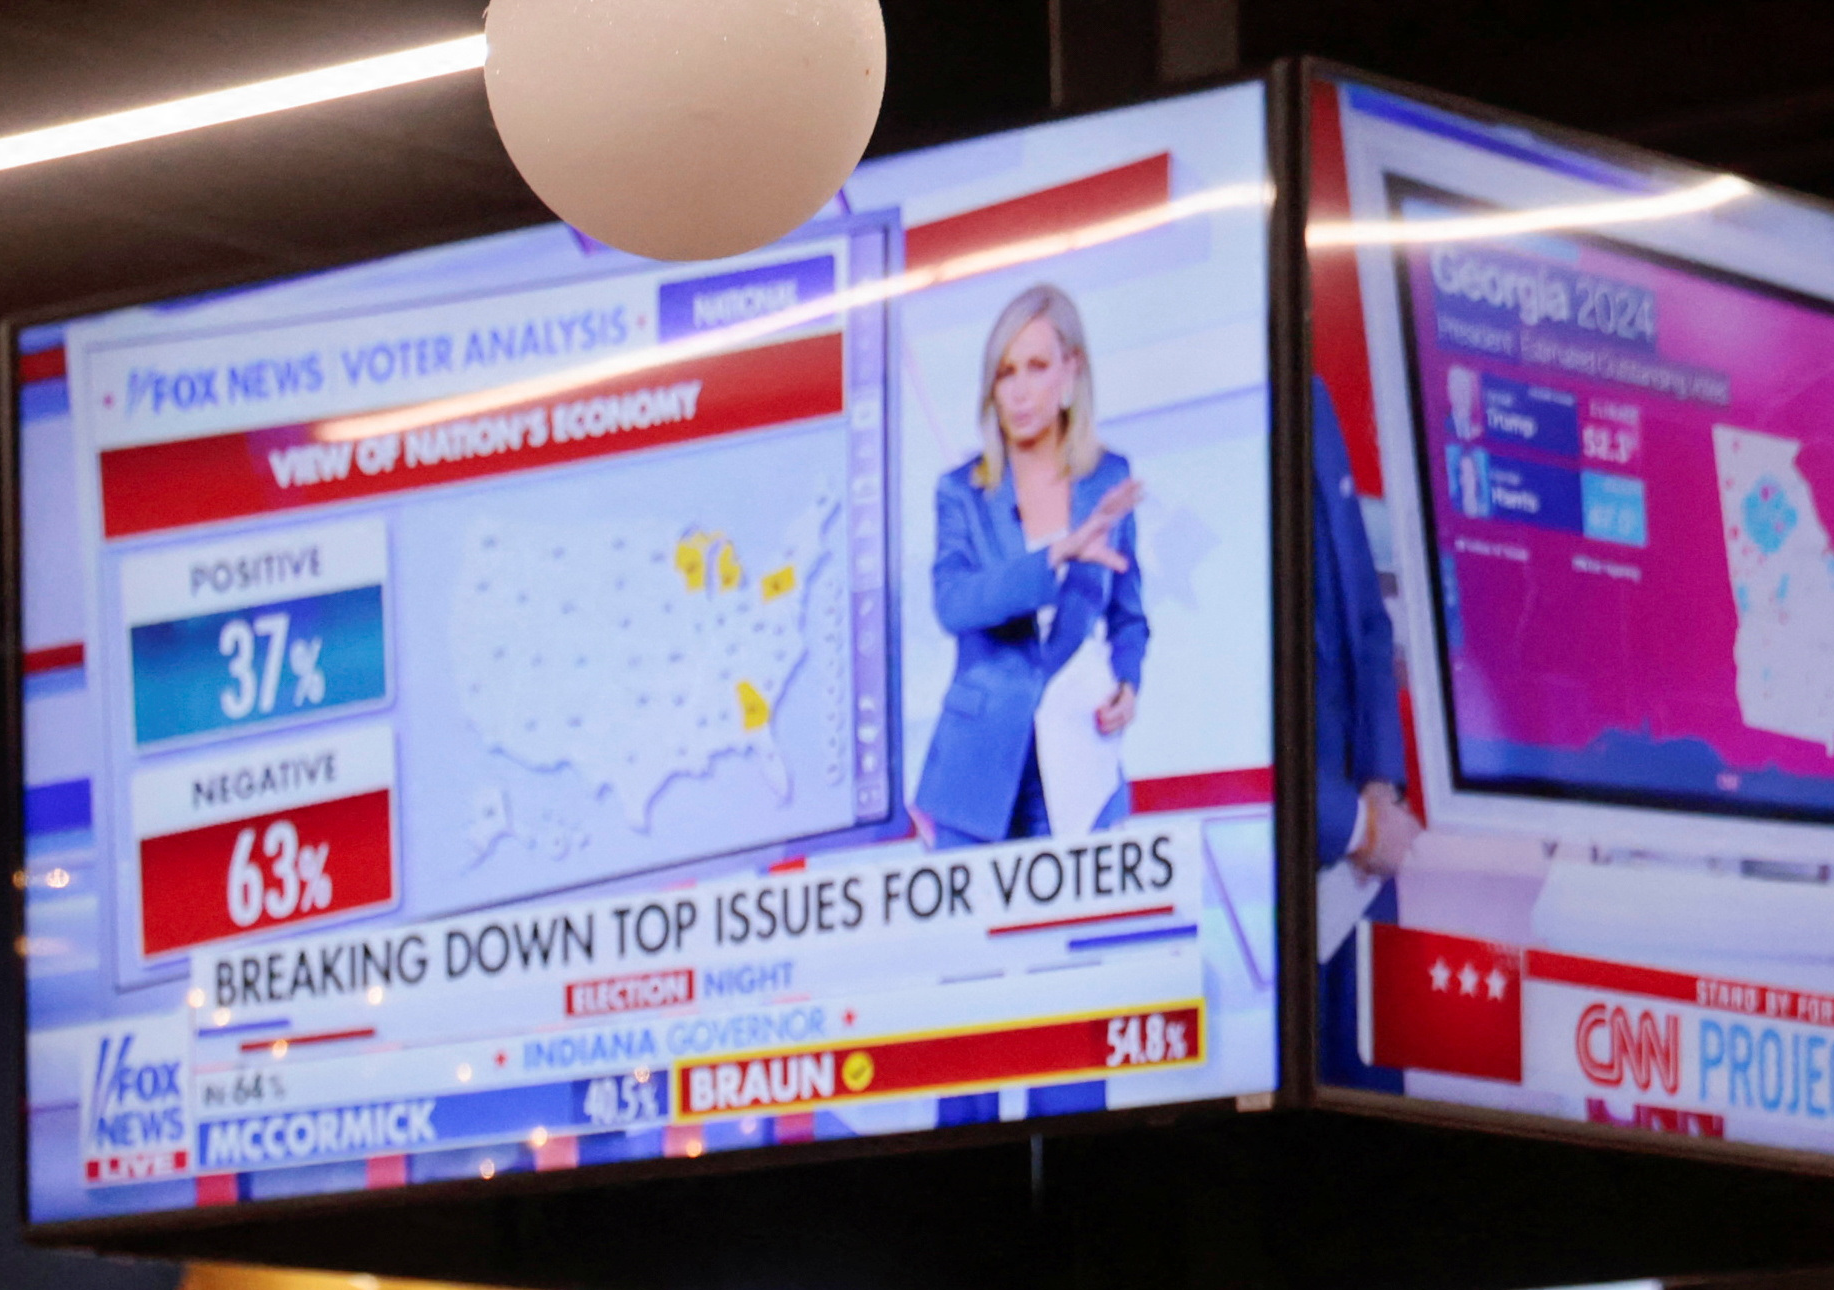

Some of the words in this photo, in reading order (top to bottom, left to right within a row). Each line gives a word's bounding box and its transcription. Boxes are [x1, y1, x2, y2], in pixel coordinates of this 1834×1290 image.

[1430, 244, 1572, 326] Georgia
[1575, 282, 1655, 343] 2024
[152, 364, 221, 417] FOX
[228, 349, 324, 403] NEWS
[341, 329, 453, 386] VOTER
[464, 306, 629, 369] ANALYSIS
[268, 438, 349, 490] VIEW
[355, 430, 402, 478] OF
[405, 410, 549, 470] NATION'S
[554, 381, 703, 442] ECONOMY
[190, 548, 323, 597] POSITIVE
[218, 611, 327, 720] 37%
[193, 752, 337, 809] NEGATIVE
[226, 820, 334, 928] 63%
[214, 934, 429, 1008] BREAKING
[445, 915, 595, 980] DOWN
[614, 901, 696, 959] TOP
[714, 876, 864, 944] ISSUES
[881, 862, 971, 918] FOR
[990, 833, 1175, 911] VOTERS
[573, 969, 691, 1012] ELECTION
[703, 961, 797, 999] NIGHT
[523, 1028, 657, 1070] INDIANA
[672, 1007, 828, 1057] GOVERNOR
[1575, 1001, 1681, 1097] CNN
[116, 1060, 181, 1102] FOX
[689, 1051, 835, 1111] BRAUN
[97, 1107, 185, 1149] NEWS
[205, 1100, 438, 1167] MCCORMICK
[101, 1151, 175, 1180] LIVE
